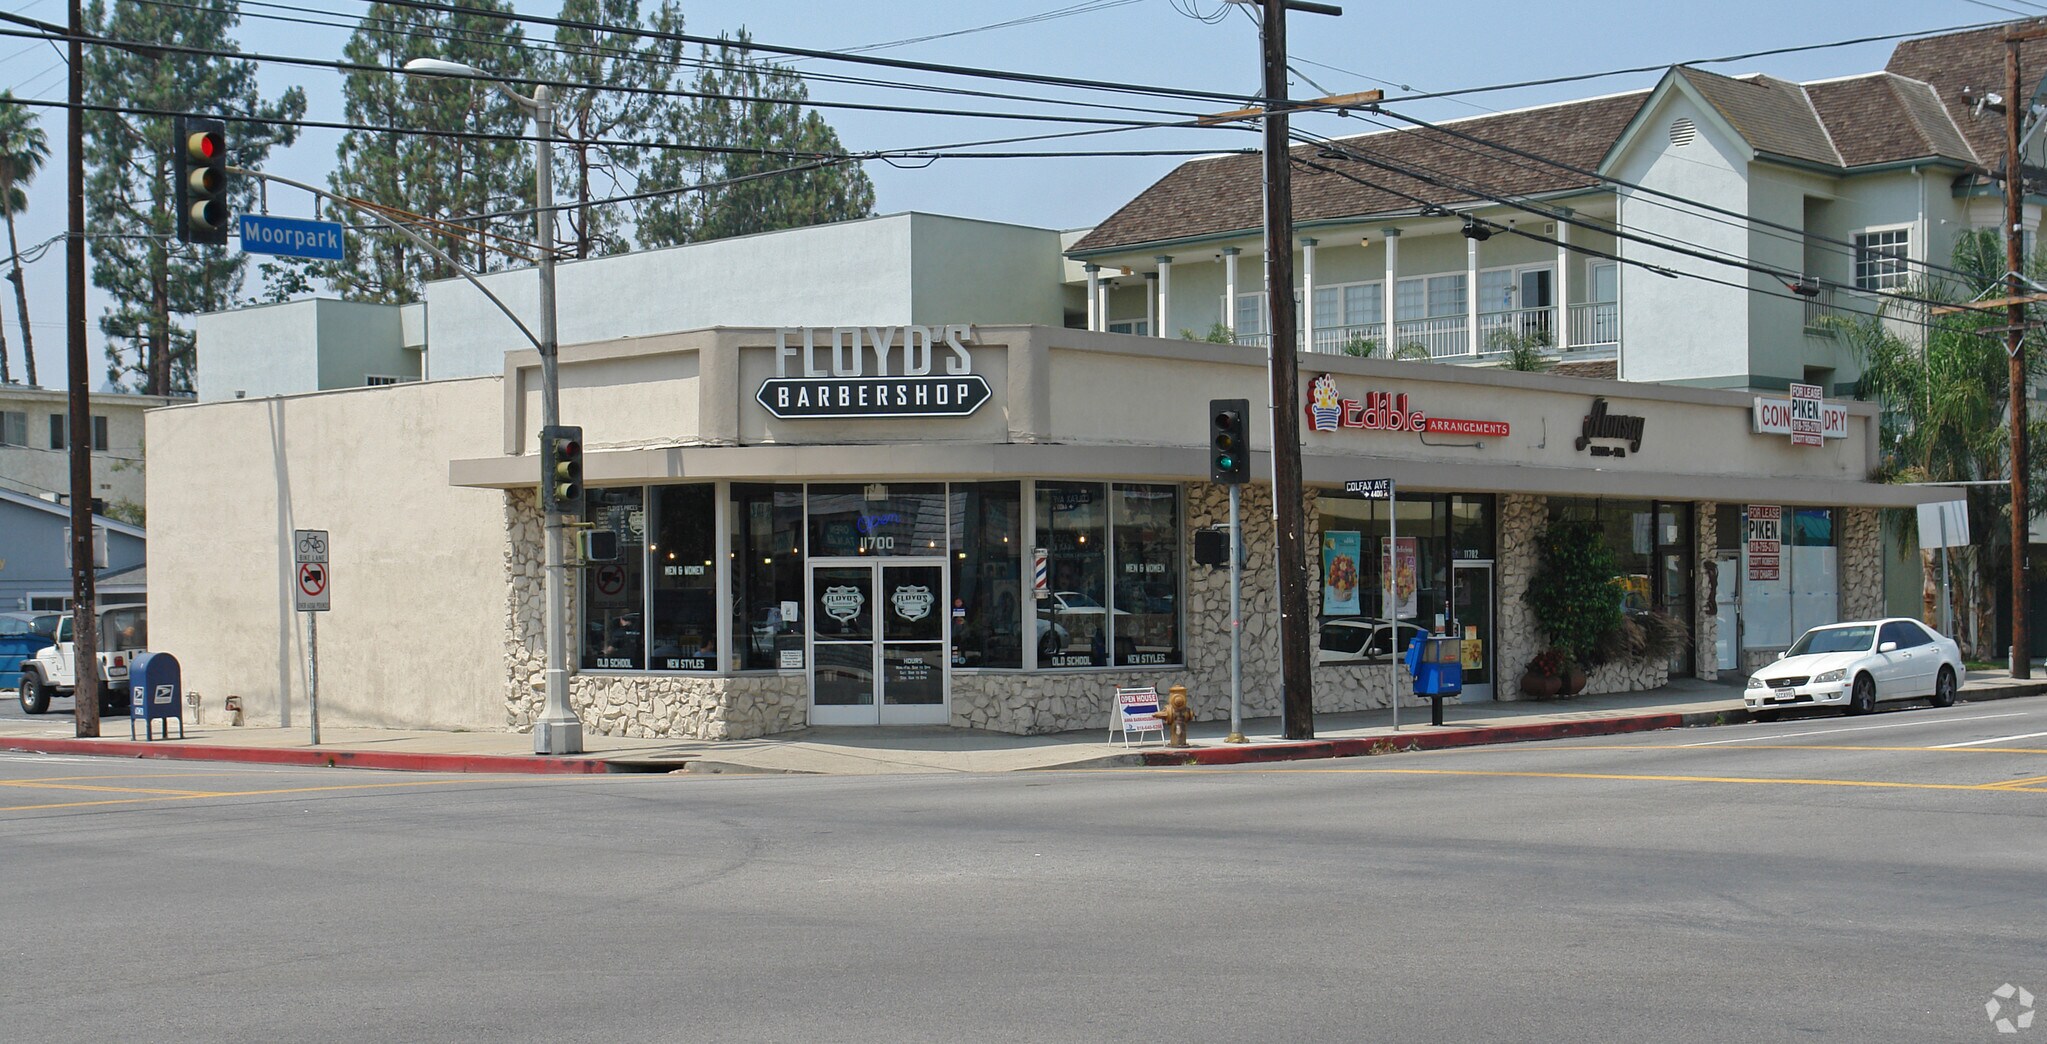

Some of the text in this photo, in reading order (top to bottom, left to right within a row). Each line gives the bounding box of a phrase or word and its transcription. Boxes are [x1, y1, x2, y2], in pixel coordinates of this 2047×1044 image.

[245, 221, 338, 250] Moorpark
[776, 324, 971, 378] FLOYD'S
[778, 384, 969, 408] BARBERSHOP
[1792, 386, 1821, 399] FOR LEASE
[1342, 391, 1426, 432] Edible
[1792, 399, 1819, 420] PIKEN
[1762, 405, 1846, 432] COIN DRY
[1430, 420, 1508, 435] ARRANGEMENTS
[1346, 481, 1372, 492] COLFAX
[1370, 490, 1384, 498] 4400
[1749, 507, 1780, 519] FOR LEASE
[856, 512, 901, 534] Open
[1749, 520, 1777, 539] PIKEN
[860, 536, 895, 550] 11700
[664, 566, 704, 575] MEN & WOMEN
[1125, 563, 1166, 573] MEN & WOMEN
[597, 658, 633, 668] OLD SCHOOL
[667, 658, 705, 669] NEW STYLES
[1052, 655, 1092, 666] OLD SCHOOL
[1127, 653, 1166, 664] NEW STYLES
[1120, 694, 1156, 703] OPEN HOUSE
